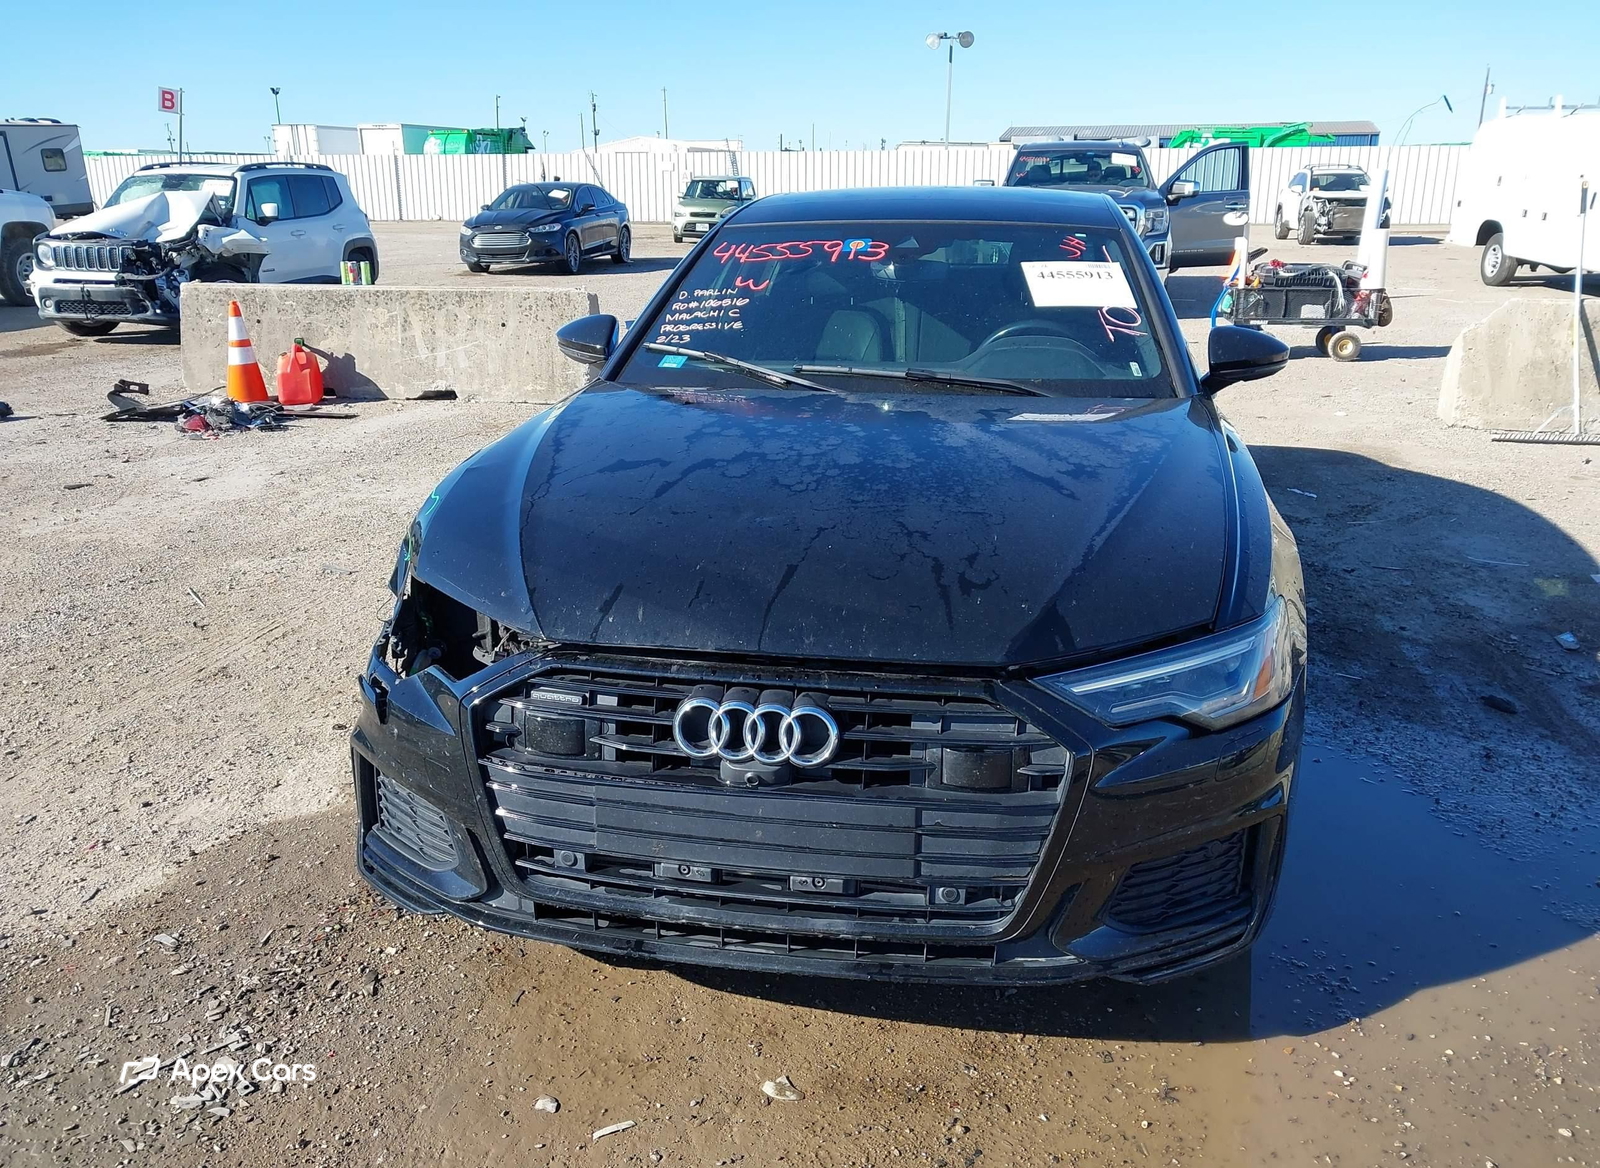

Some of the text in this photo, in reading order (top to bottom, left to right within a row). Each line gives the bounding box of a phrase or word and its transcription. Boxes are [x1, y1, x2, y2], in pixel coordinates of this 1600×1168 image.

[162, 90, 175, 109] B
[714, 241, 888, 263] 44555913
[1037, 271, 1113, 280] 44555913
[694, 288, 738, 297] PARLIN
[728, 309, 740, 317] C
[660, 321, 743, 333] PROGRESSIVE
[533, 693, 580, 703] quattro
